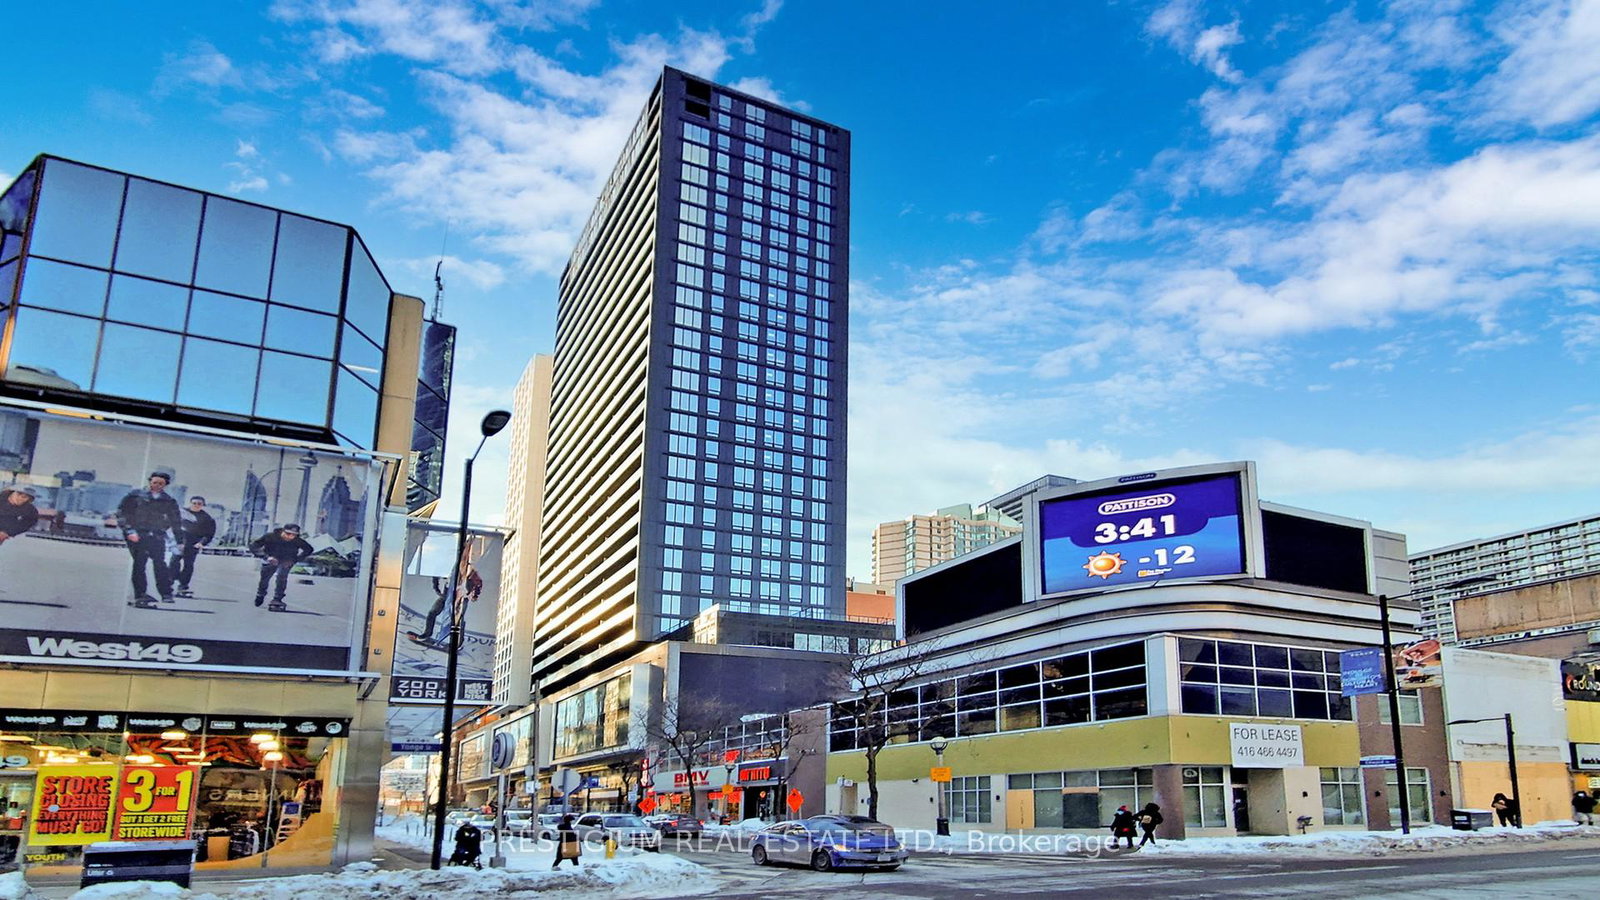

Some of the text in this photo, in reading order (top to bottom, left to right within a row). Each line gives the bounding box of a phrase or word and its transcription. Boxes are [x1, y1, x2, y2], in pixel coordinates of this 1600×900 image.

[1104, 496, 1169, 512] PATTISON
[1094, 514, 1175, 544] 3:41
[1139, 545, 1196, 566] -12
[27, 636, 203, 663] West49
[398, 680, 438, 690] ZOO
[398, 689, 447, 699] YORK
[1234, 728, 1298, 742] FOR LEASE
[1238, 746, 1255, 757] 416
[1276, 747, 1298, 758] 4497
[674, 770, 709, 783] BMV
[43, 775, 113, 795] STORE
[123, 769, 194, 812] 3 FOR 1
[41, 794, 111, 808] CLOSING
[39, 810, 108, 821] EVERYTHING
[120, 815, 137, 823] BUY
[143, 815, 160, 823] GET
[160, 815, 166, 823] 2
[167, 815, 187, 823] FREE
[37, 820, 107, 834] MUST GO!
[119, 826, 186, 838] STOREWIDE
[26, 854, 66, 862] YOUTH
